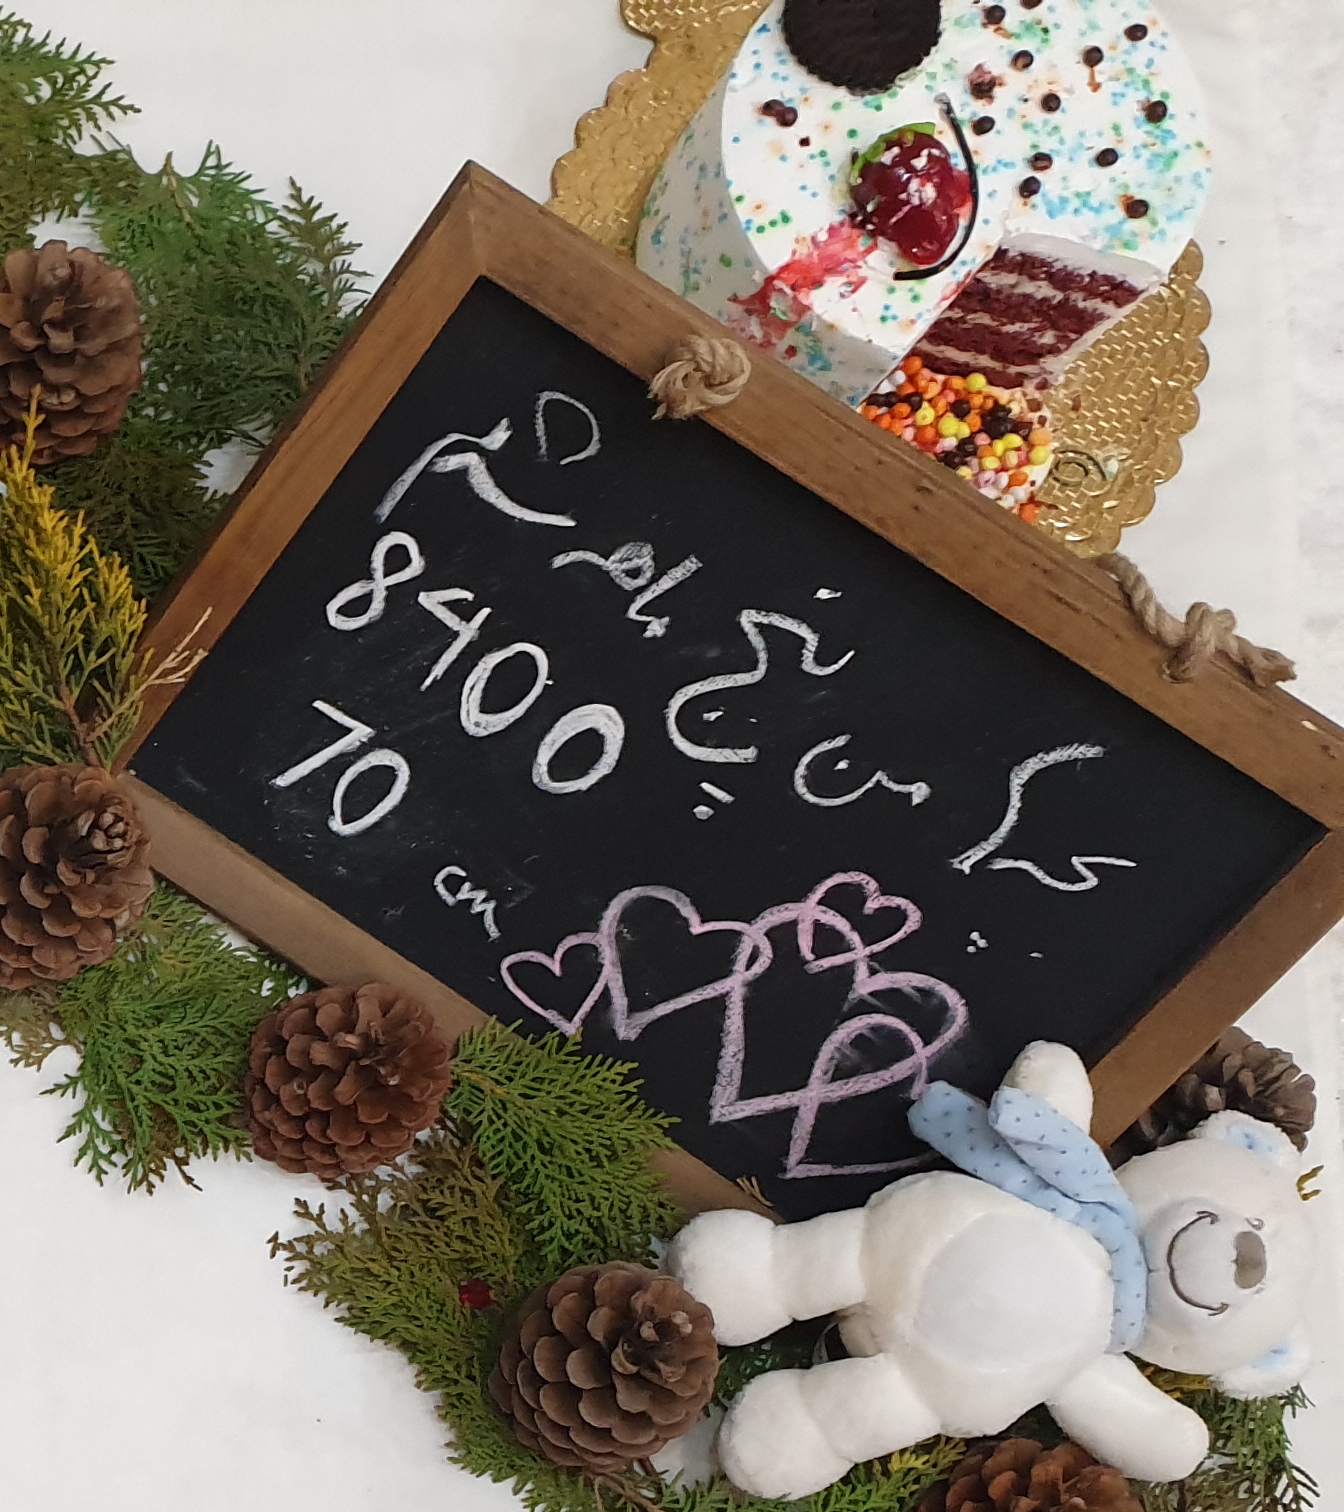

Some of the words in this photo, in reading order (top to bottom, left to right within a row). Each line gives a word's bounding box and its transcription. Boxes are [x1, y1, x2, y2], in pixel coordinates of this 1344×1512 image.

[325, 530, 626, 795] 8400
[793, 733, 932, 808] من
[268, 699, 412, 837] 70
[432, 864, 502, 944] cm
